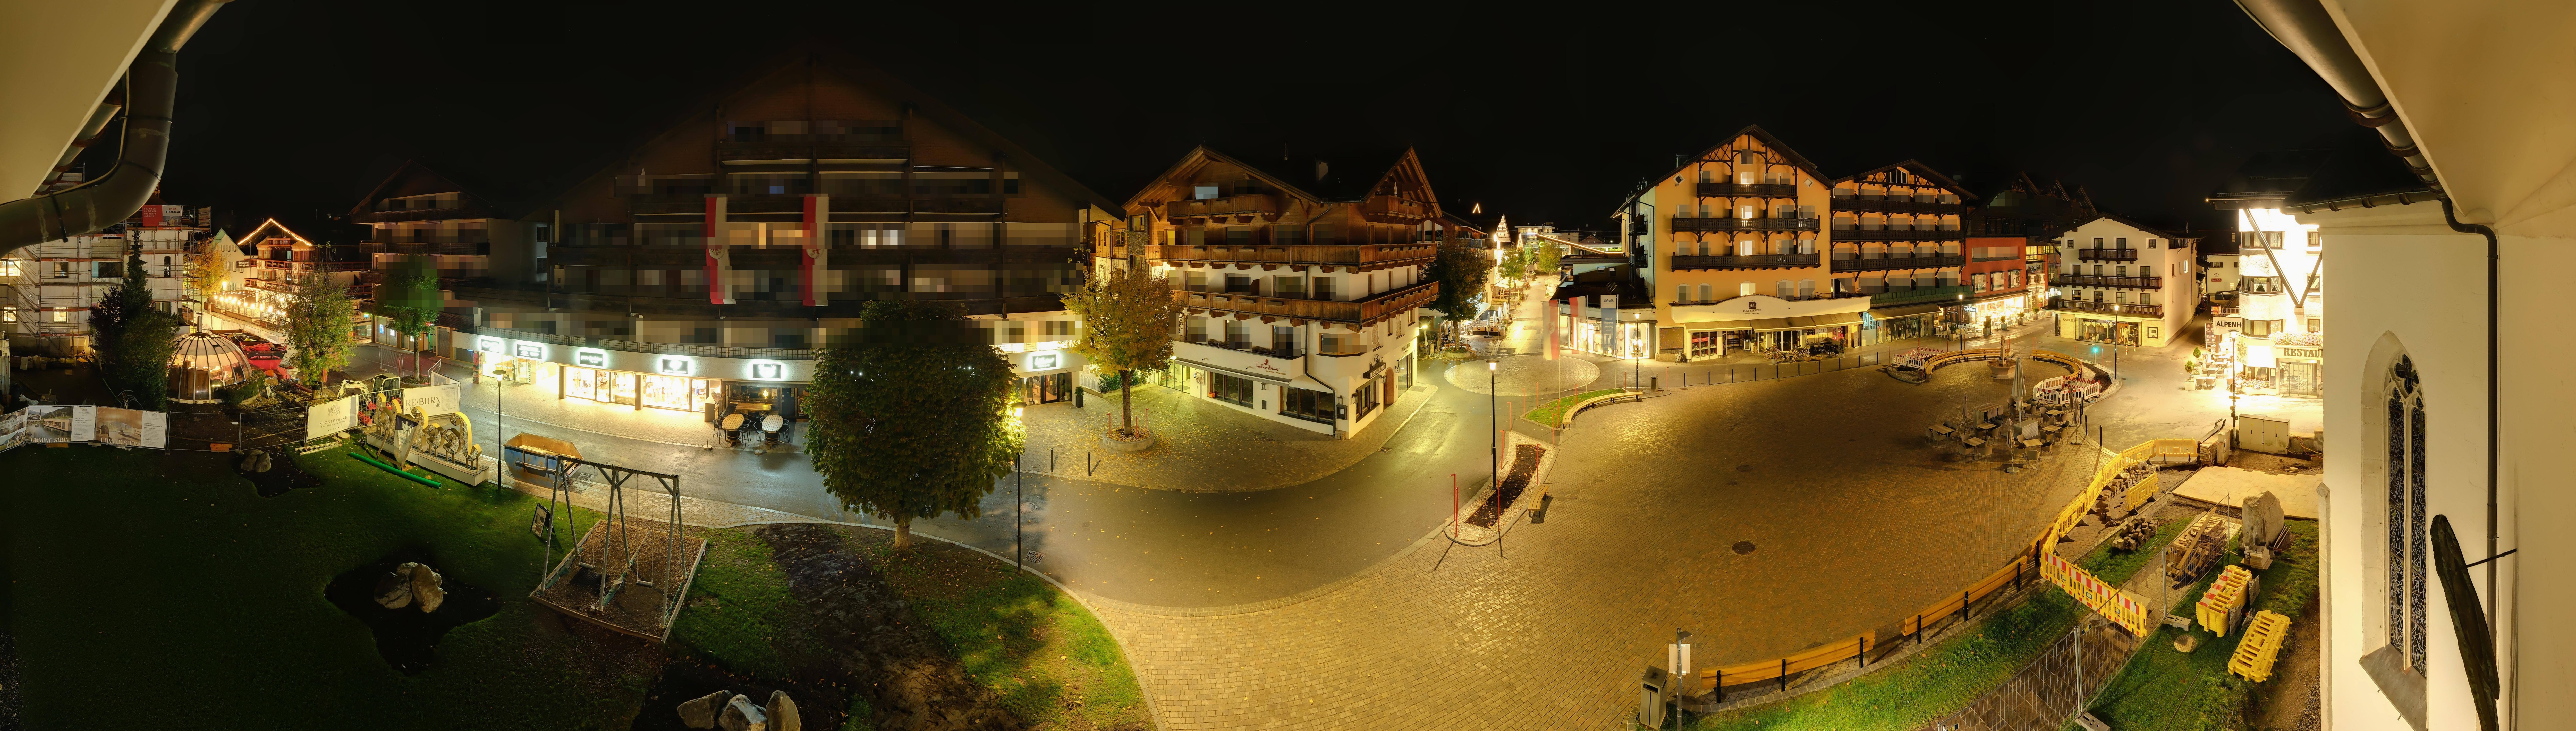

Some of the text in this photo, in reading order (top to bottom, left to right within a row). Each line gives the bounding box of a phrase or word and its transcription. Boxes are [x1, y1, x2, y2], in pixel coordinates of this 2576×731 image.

[1402, 343, 1410, 351] SAILER
[1371, 364, 1385, 377] RESTAURANT
[320, 416, 348, 425] KLOSTERBRÄU
